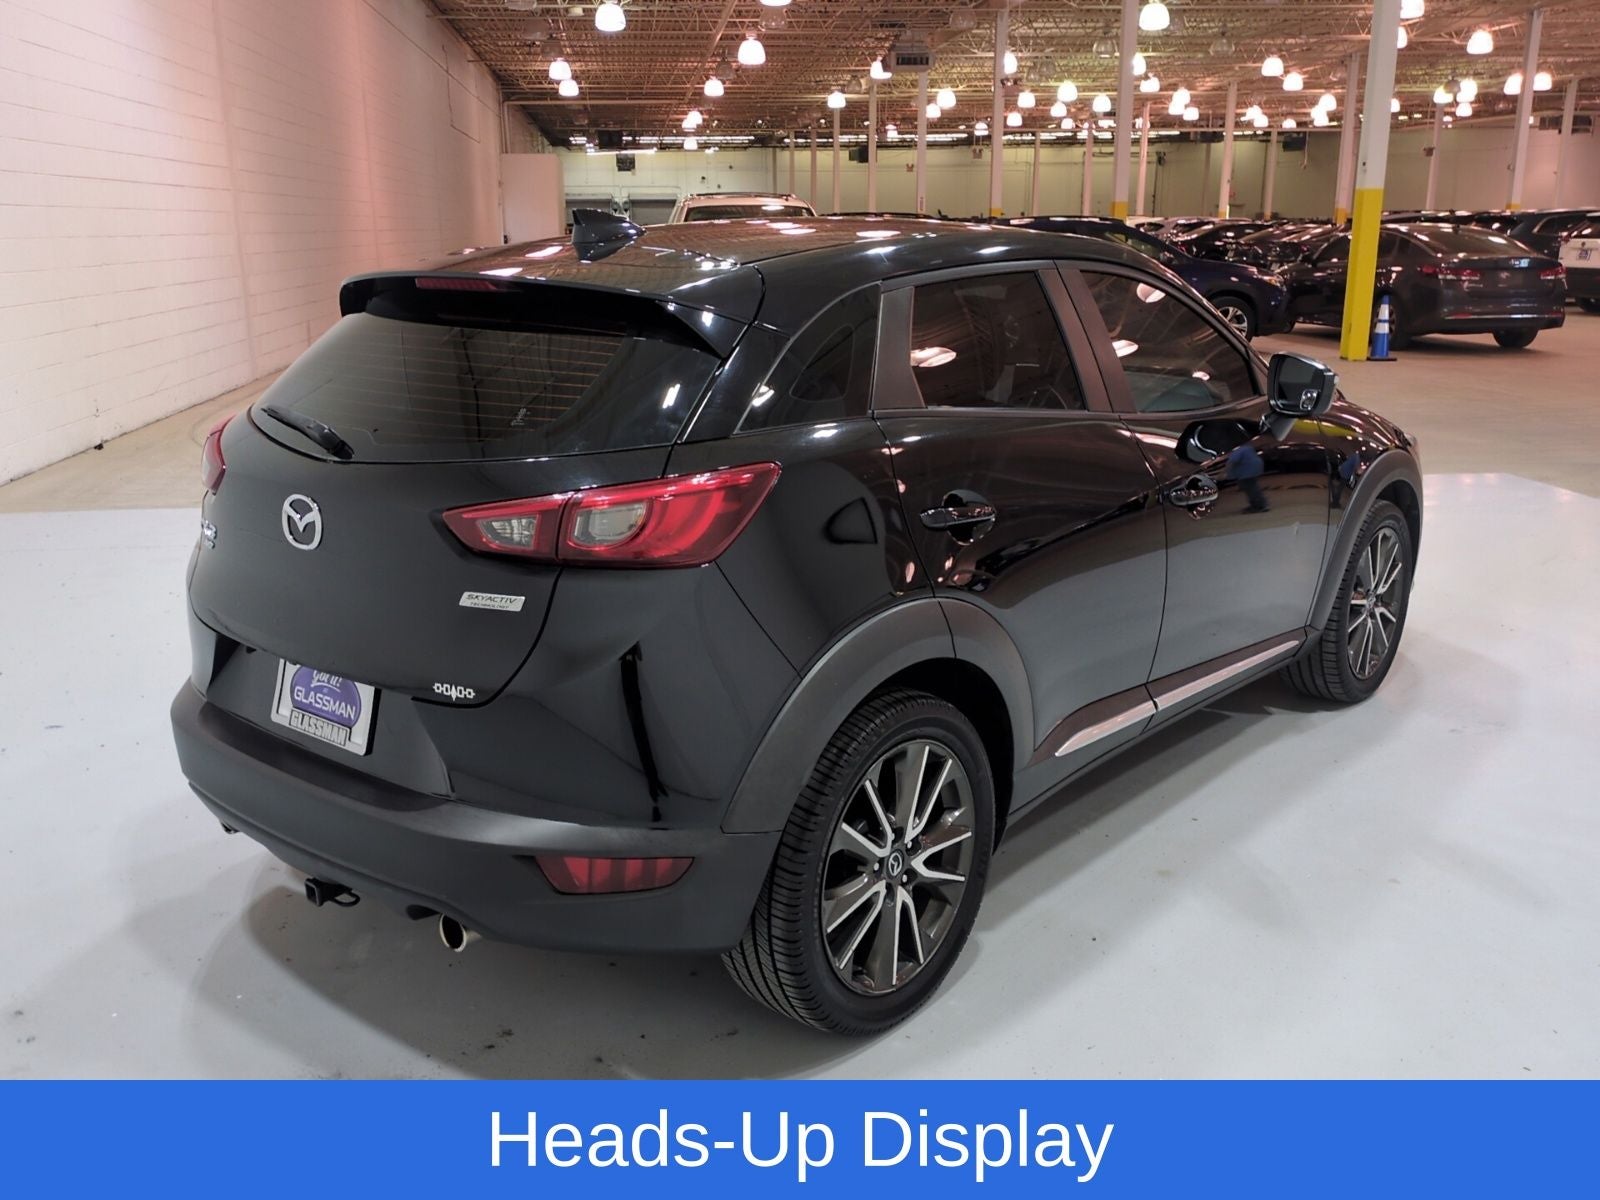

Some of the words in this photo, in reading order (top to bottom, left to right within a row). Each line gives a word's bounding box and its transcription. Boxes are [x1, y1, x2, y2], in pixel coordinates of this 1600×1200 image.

[466, 593, 518, 604] SKYACTIV
[294, 685, 356, 721] GLASSMAN
[290, 709, 347, 747] GLASSMAN
